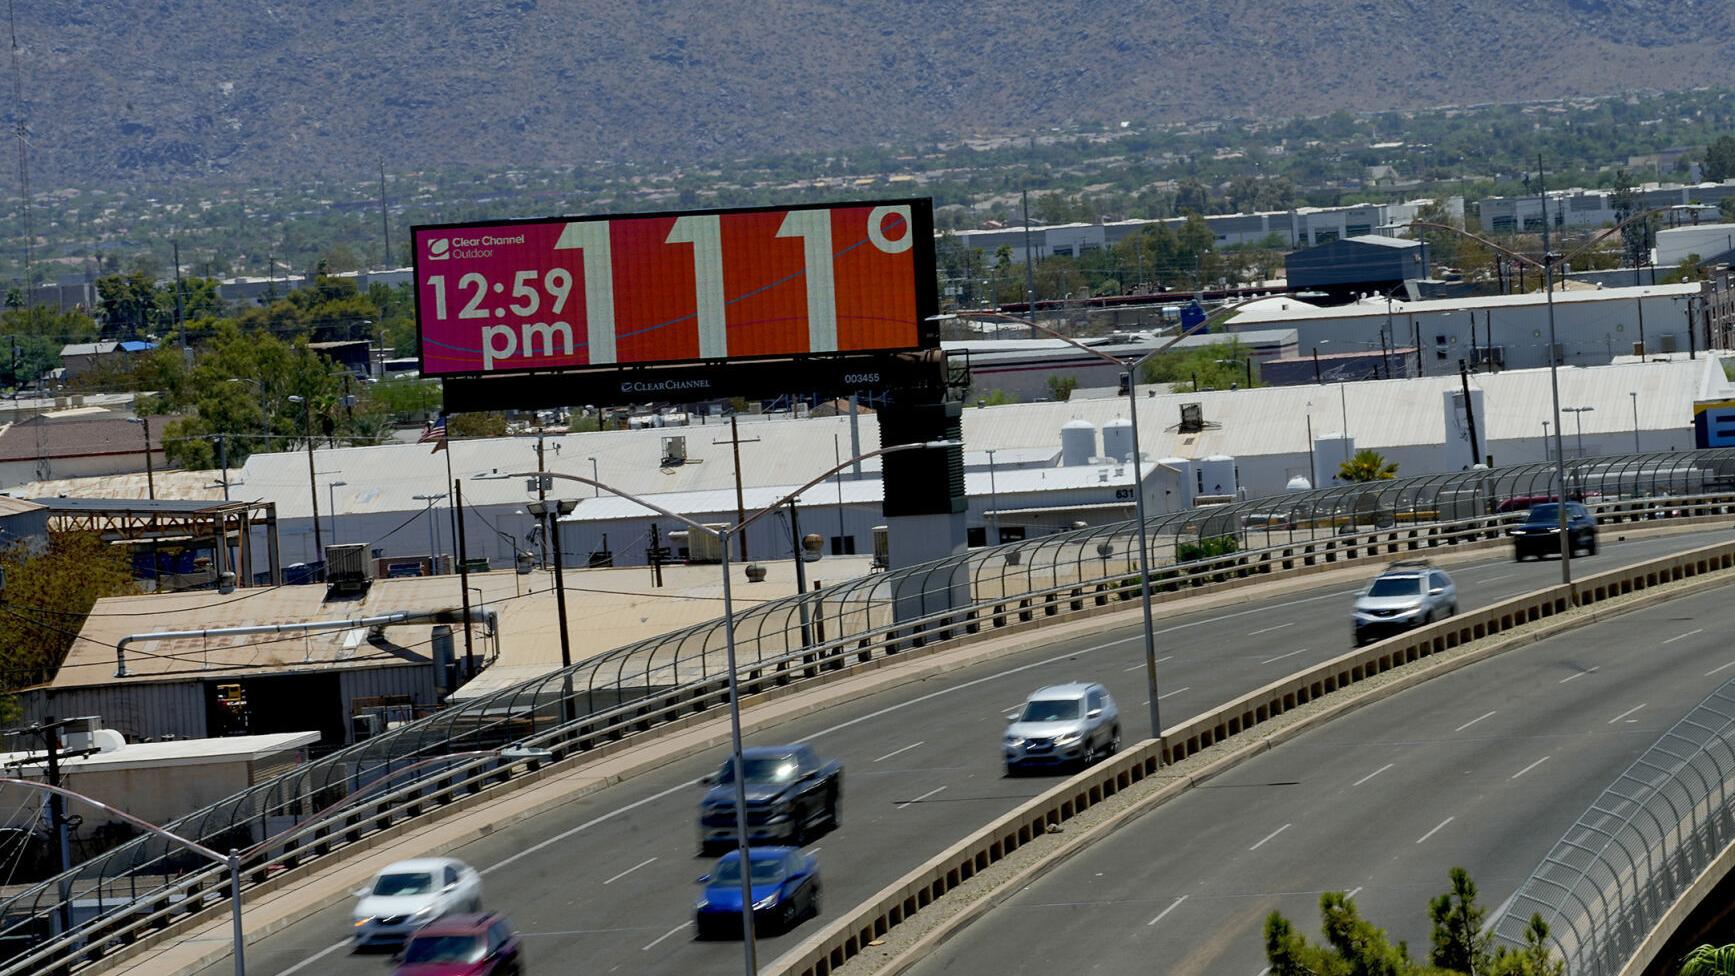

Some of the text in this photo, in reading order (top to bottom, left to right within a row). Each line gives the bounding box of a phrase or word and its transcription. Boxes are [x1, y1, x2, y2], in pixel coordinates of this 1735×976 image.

[452, 234, 525, 247] Clear Channel
[452, 248, 493, 259] Outdoor
[426, 267, 573, 321] 12:59
[481, 321, 574, 371] pm
[844, 373, 880, 384] 003455
